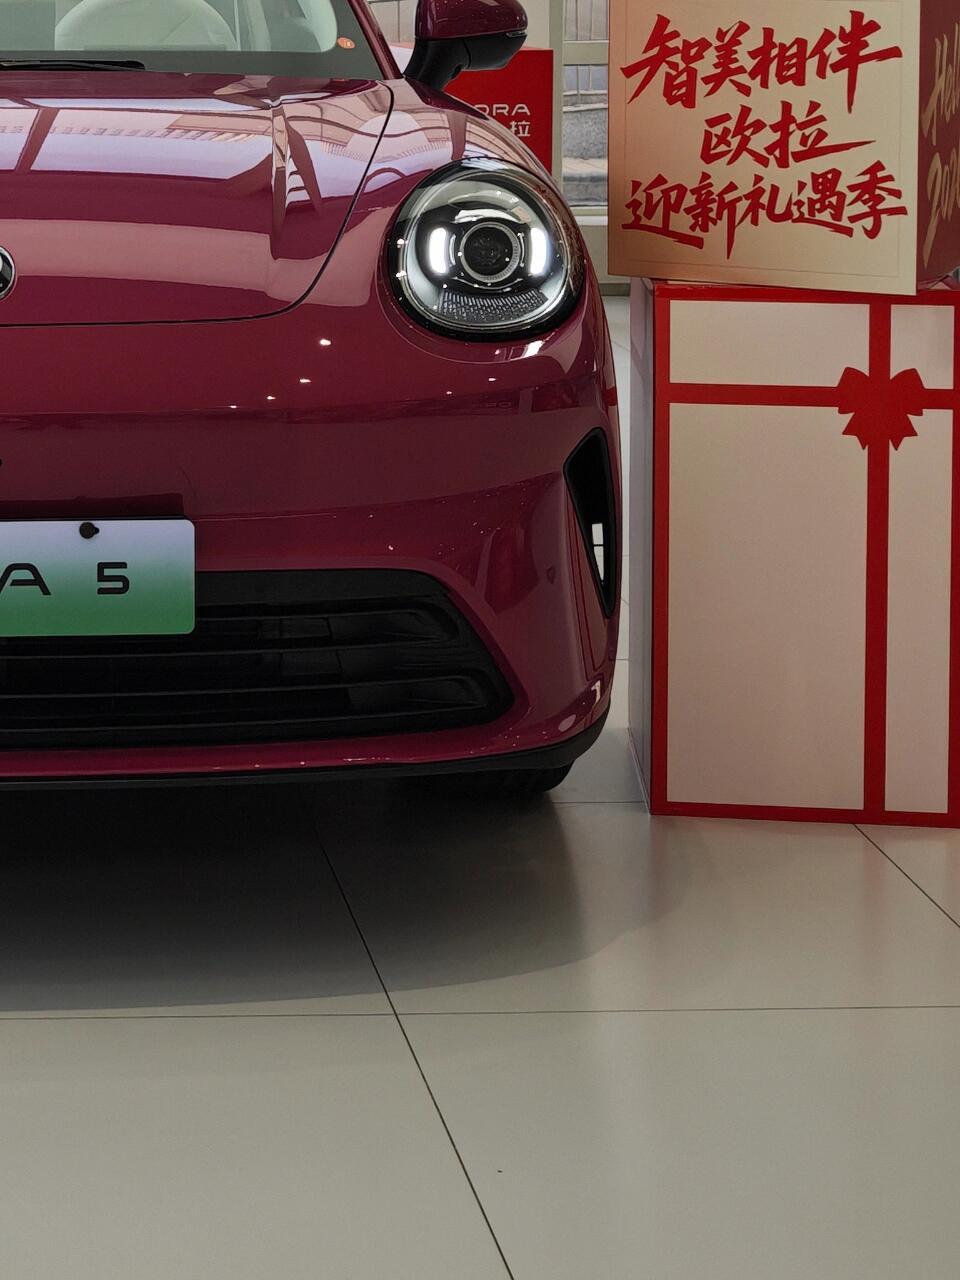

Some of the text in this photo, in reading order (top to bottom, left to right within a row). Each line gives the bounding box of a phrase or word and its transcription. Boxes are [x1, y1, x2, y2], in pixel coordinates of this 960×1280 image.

[620, 9, 903, 113] 智美相伴
[699, 100, 876, 169] 欧拉
[620, 160, 908, 260] 迎新礼遇季
[96, 561, 131, 596] 5
